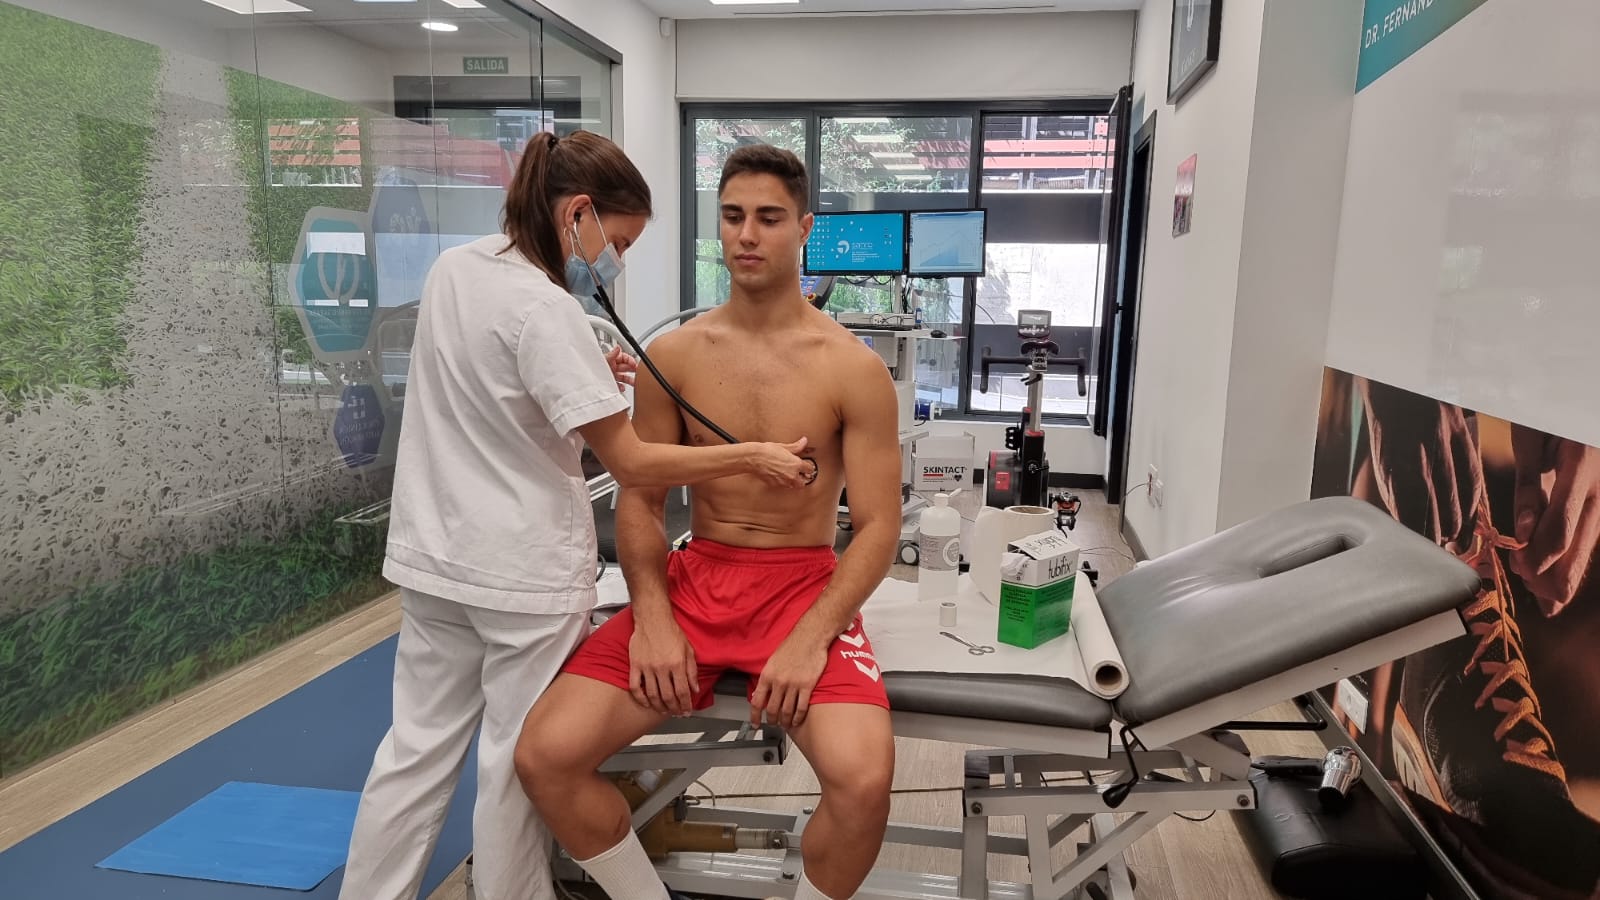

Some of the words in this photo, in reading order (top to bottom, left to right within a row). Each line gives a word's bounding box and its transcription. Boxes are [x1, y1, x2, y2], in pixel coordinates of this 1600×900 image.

[1365, 23, 1380, 48] DR.
[466, 59, 505, 71] SALIDA
[923, 466, 966, 474] SKINTACT
[1048, 555, 1071, 579] tubifix
